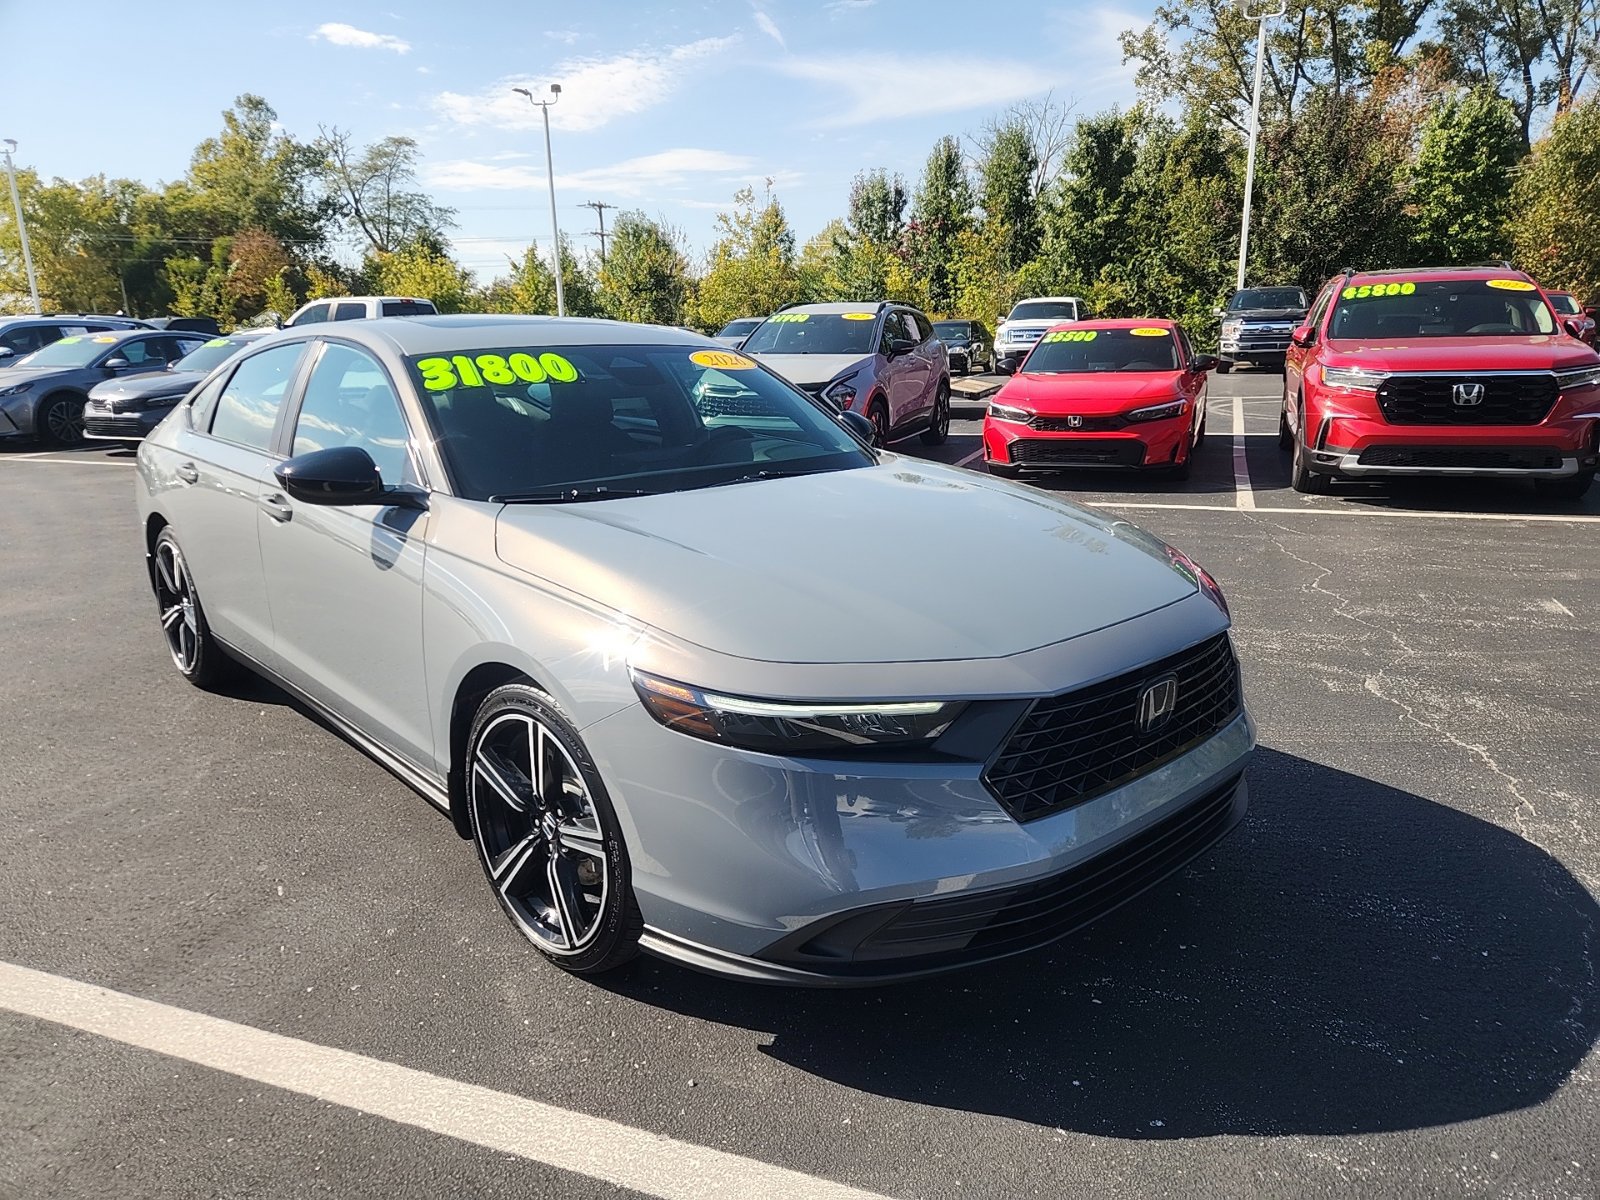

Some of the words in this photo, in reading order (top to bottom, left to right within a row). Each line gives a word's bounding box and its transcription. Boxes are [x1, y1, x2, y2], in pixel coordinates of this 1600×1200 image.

[1341, 282, 1416, 300] 45800
[1041, 330, 1098, 343] 25500
[703, 354, 747, 366] 2026
[416, 352, 580, 392] 31800
